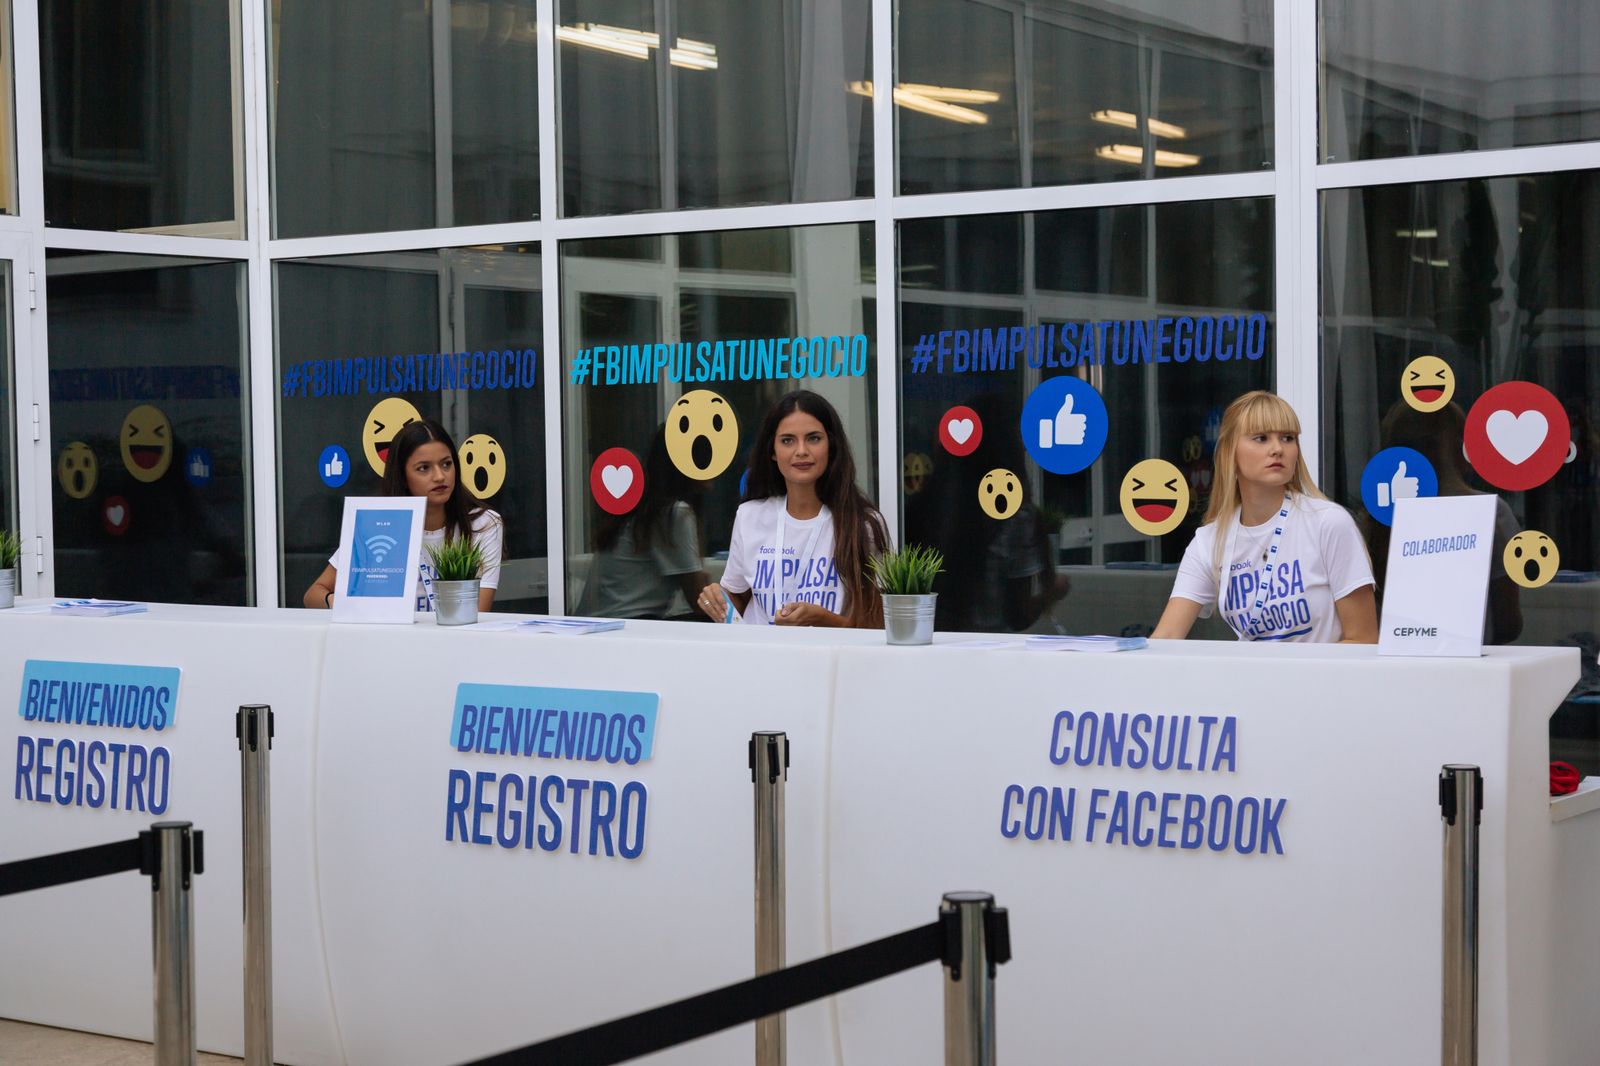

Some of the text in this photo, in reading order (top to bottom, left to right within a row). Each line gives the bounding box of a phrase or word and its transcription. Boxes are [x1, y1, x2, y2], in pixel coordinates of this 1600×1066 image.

[282, 349, 537, 397] #FBIMPULSATUNEGOCIO
[570, 334, 868, 386] #FBIMPULSATUNEGOCIO
[911, 313, 1268, 374] #FBIMPULSATUNEGOCIO
[1402, 534, 1477, 557] COLABORADOR
[1393, 627, 1438, 637] CEPYME
[24, 679, 170, 731] BIENVENIDOS
[457, 704, 646, 765] BIENVENIDOS
[1049, 710, 1237, 772] CONSULTA
[15, 736, 170, 816] REGISTRO
[445, 769, 647, 859] REGISTRO
[1000, 784, 1288, 855] CON FACEBOOK
